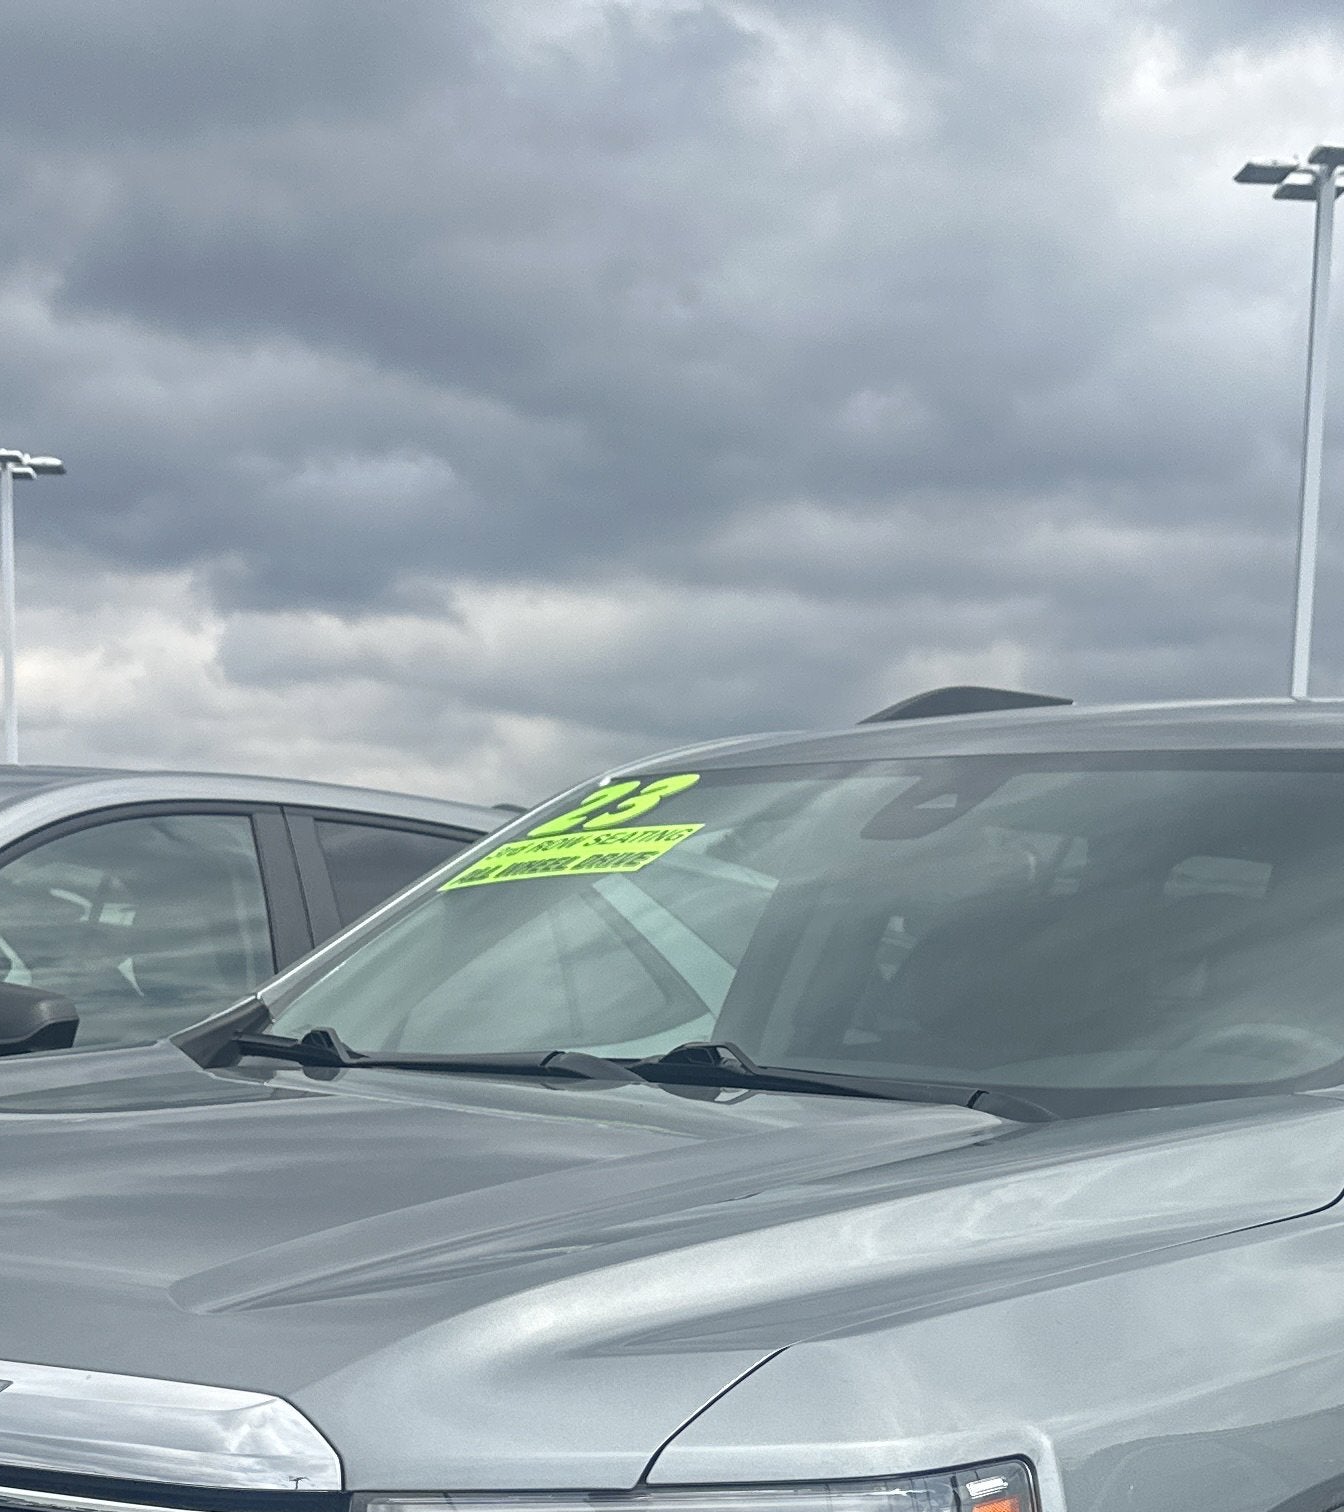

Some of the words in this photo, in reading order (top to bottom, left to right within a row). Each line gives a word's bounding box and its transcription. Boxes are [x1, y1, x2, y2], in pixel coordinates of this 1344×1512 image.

[527, 773, 701, 837] 23
[525, 835, 591, 854] ROW
[582, 828, 694, 847] SEATING
[570, 851, 660, 870] DRIVE
